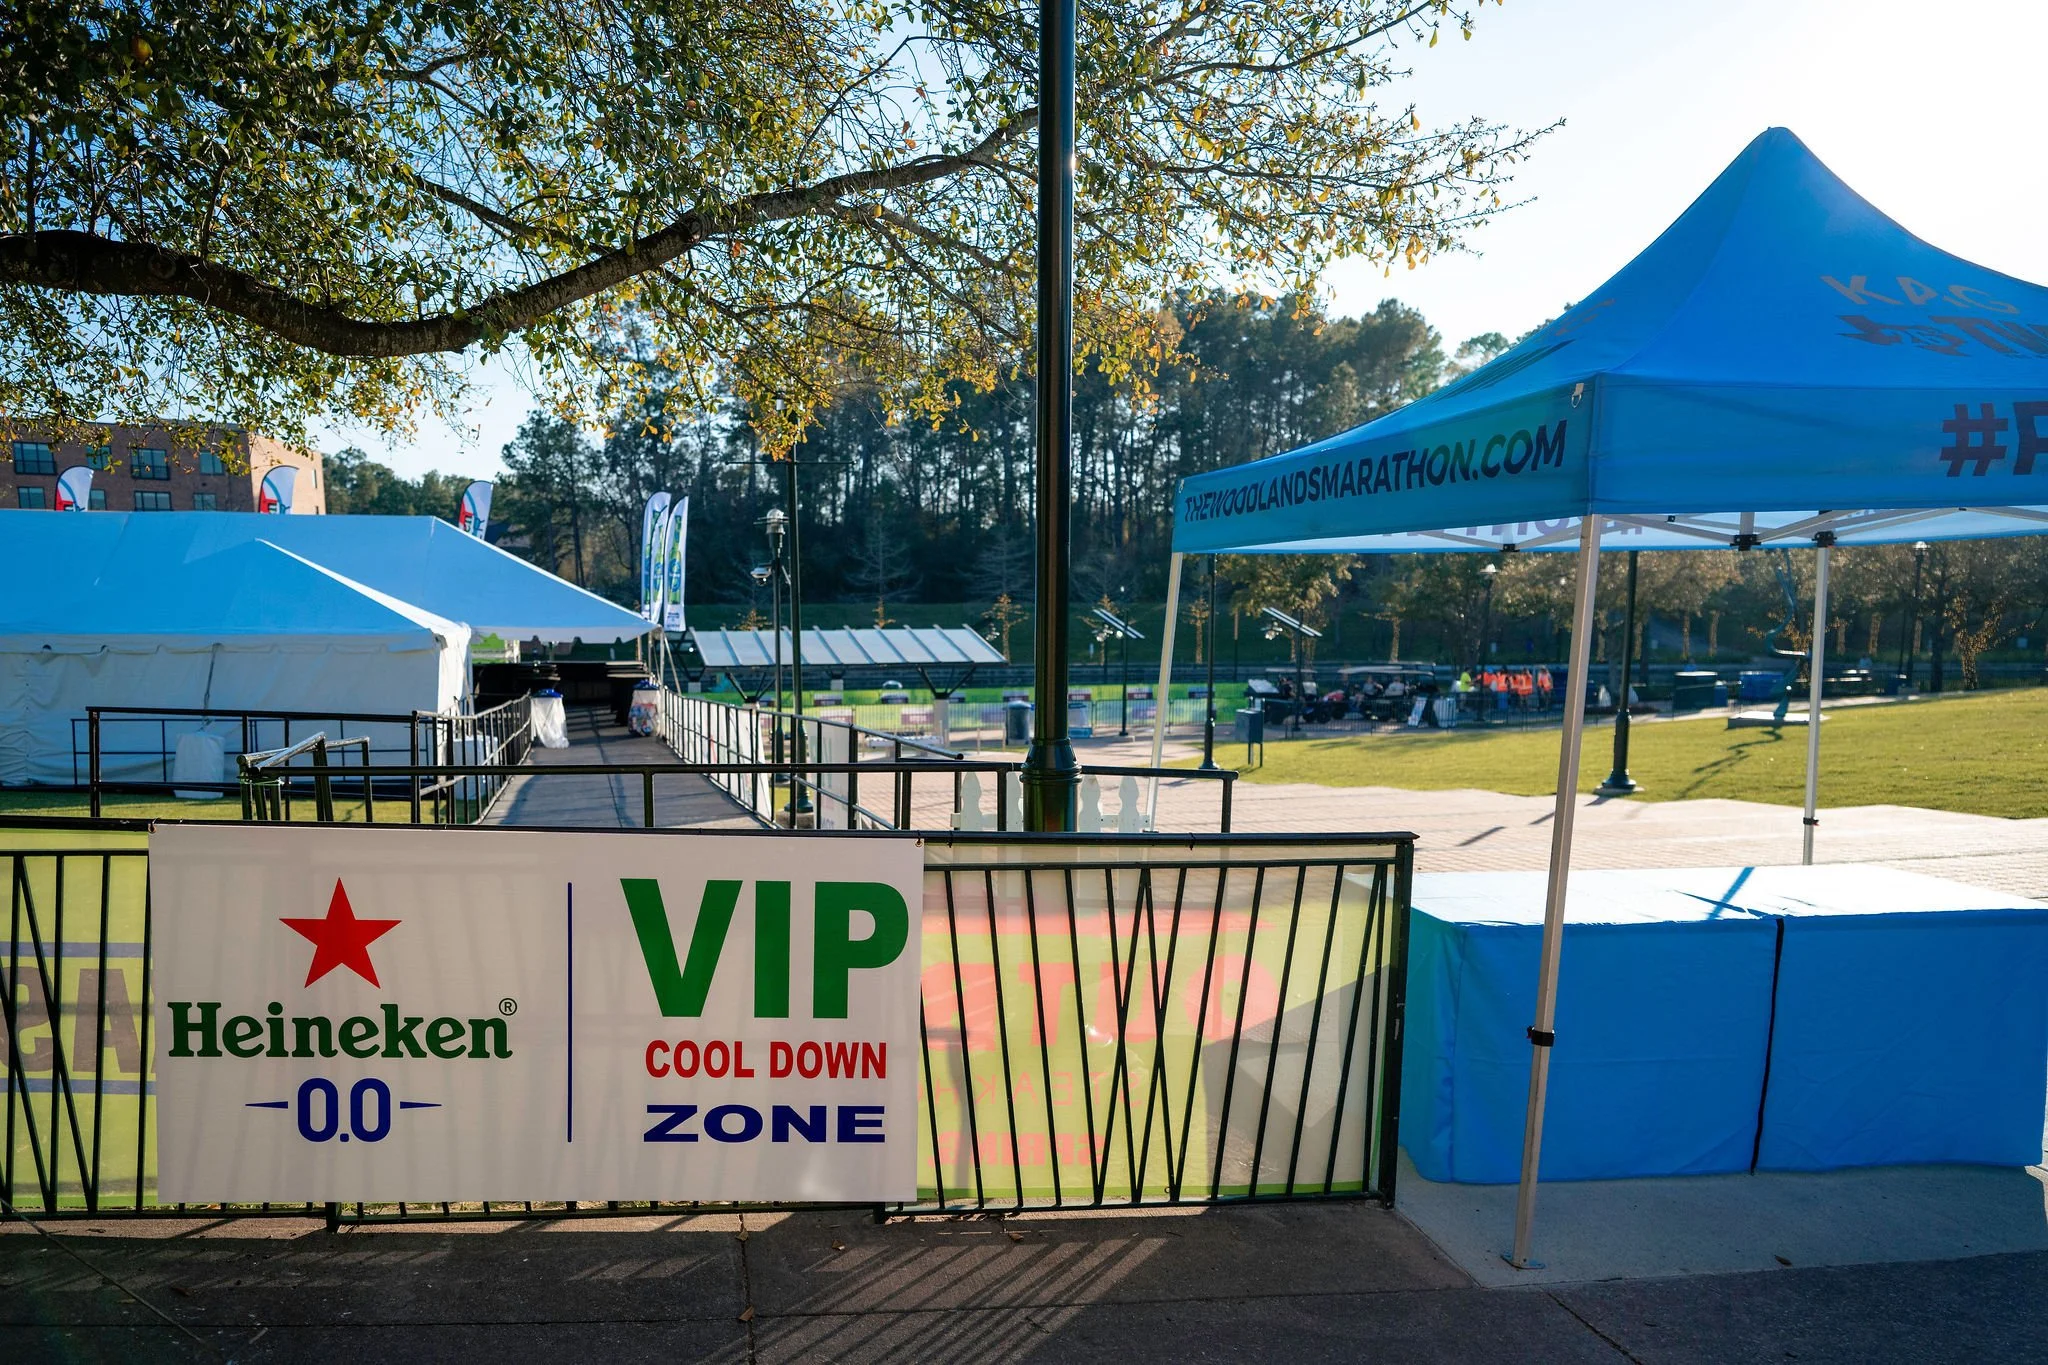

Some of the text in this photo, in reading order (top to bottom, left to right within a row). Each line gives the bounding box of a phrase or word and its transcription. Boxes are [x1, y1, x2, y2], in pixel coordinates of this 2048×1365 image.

[1184, 419, 1568, 523] THEWOODLANDSMARATHON.COM
[620, 878, 909, 1019] VIP
[645, 1039, 887, 1080] COOL DOWN
[297, 1077, 391, 1143] 0.0
[643, 1104, 885, 1143] ZONE
